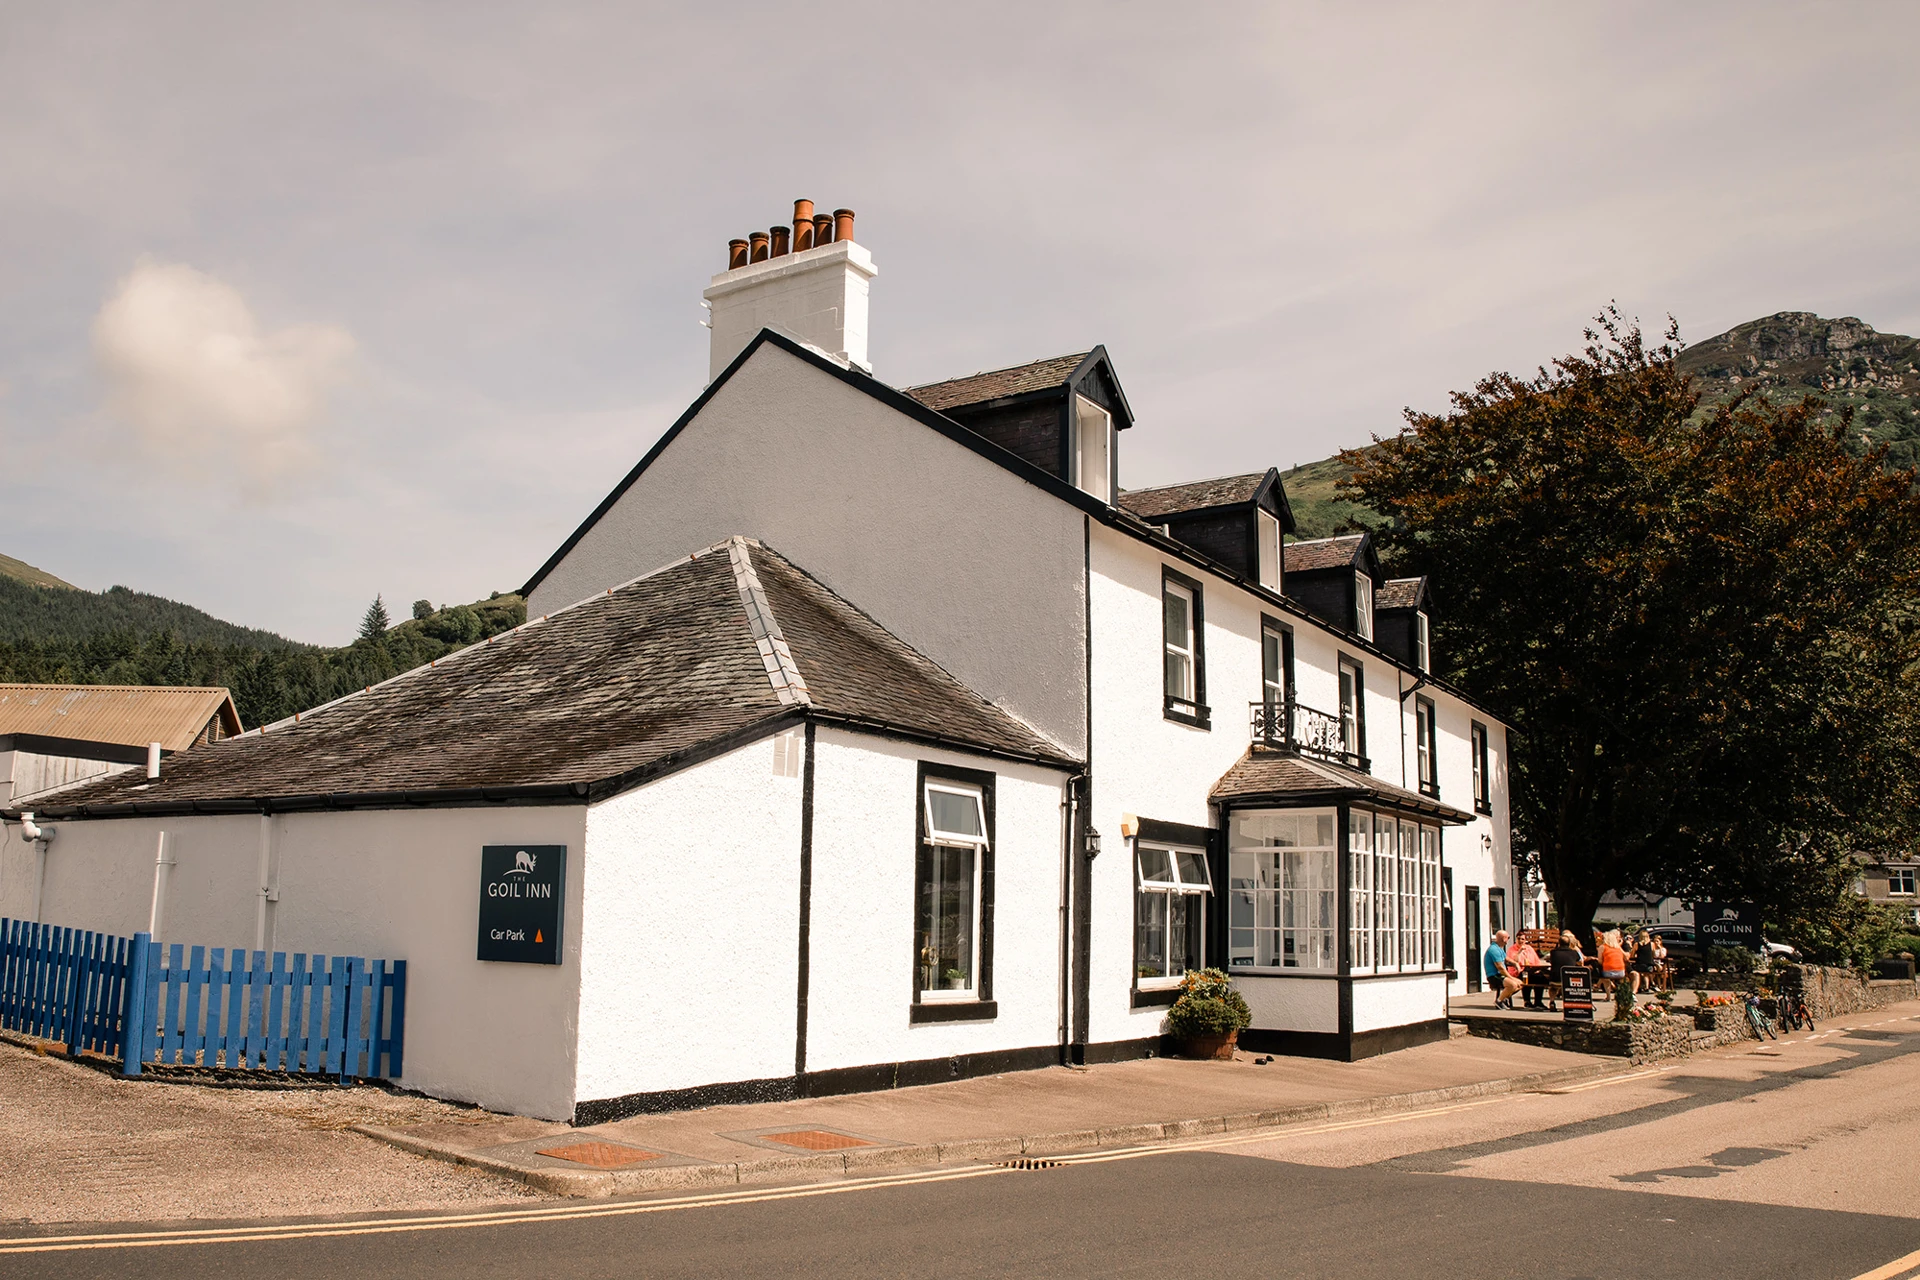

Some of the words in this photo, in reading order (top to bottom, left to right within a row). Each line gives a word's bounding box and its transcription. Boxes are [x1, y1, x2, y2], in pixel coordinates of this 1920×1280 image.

[488, 882, 521, 898] GOIL
[525, 883, 551, 898] INN
[490, 928, 505, 940] Car
[506, 929, 525, 941] Park
[1702, 924, 1729, 934] GOIL
[1733, 925, 1752, 934] INN
